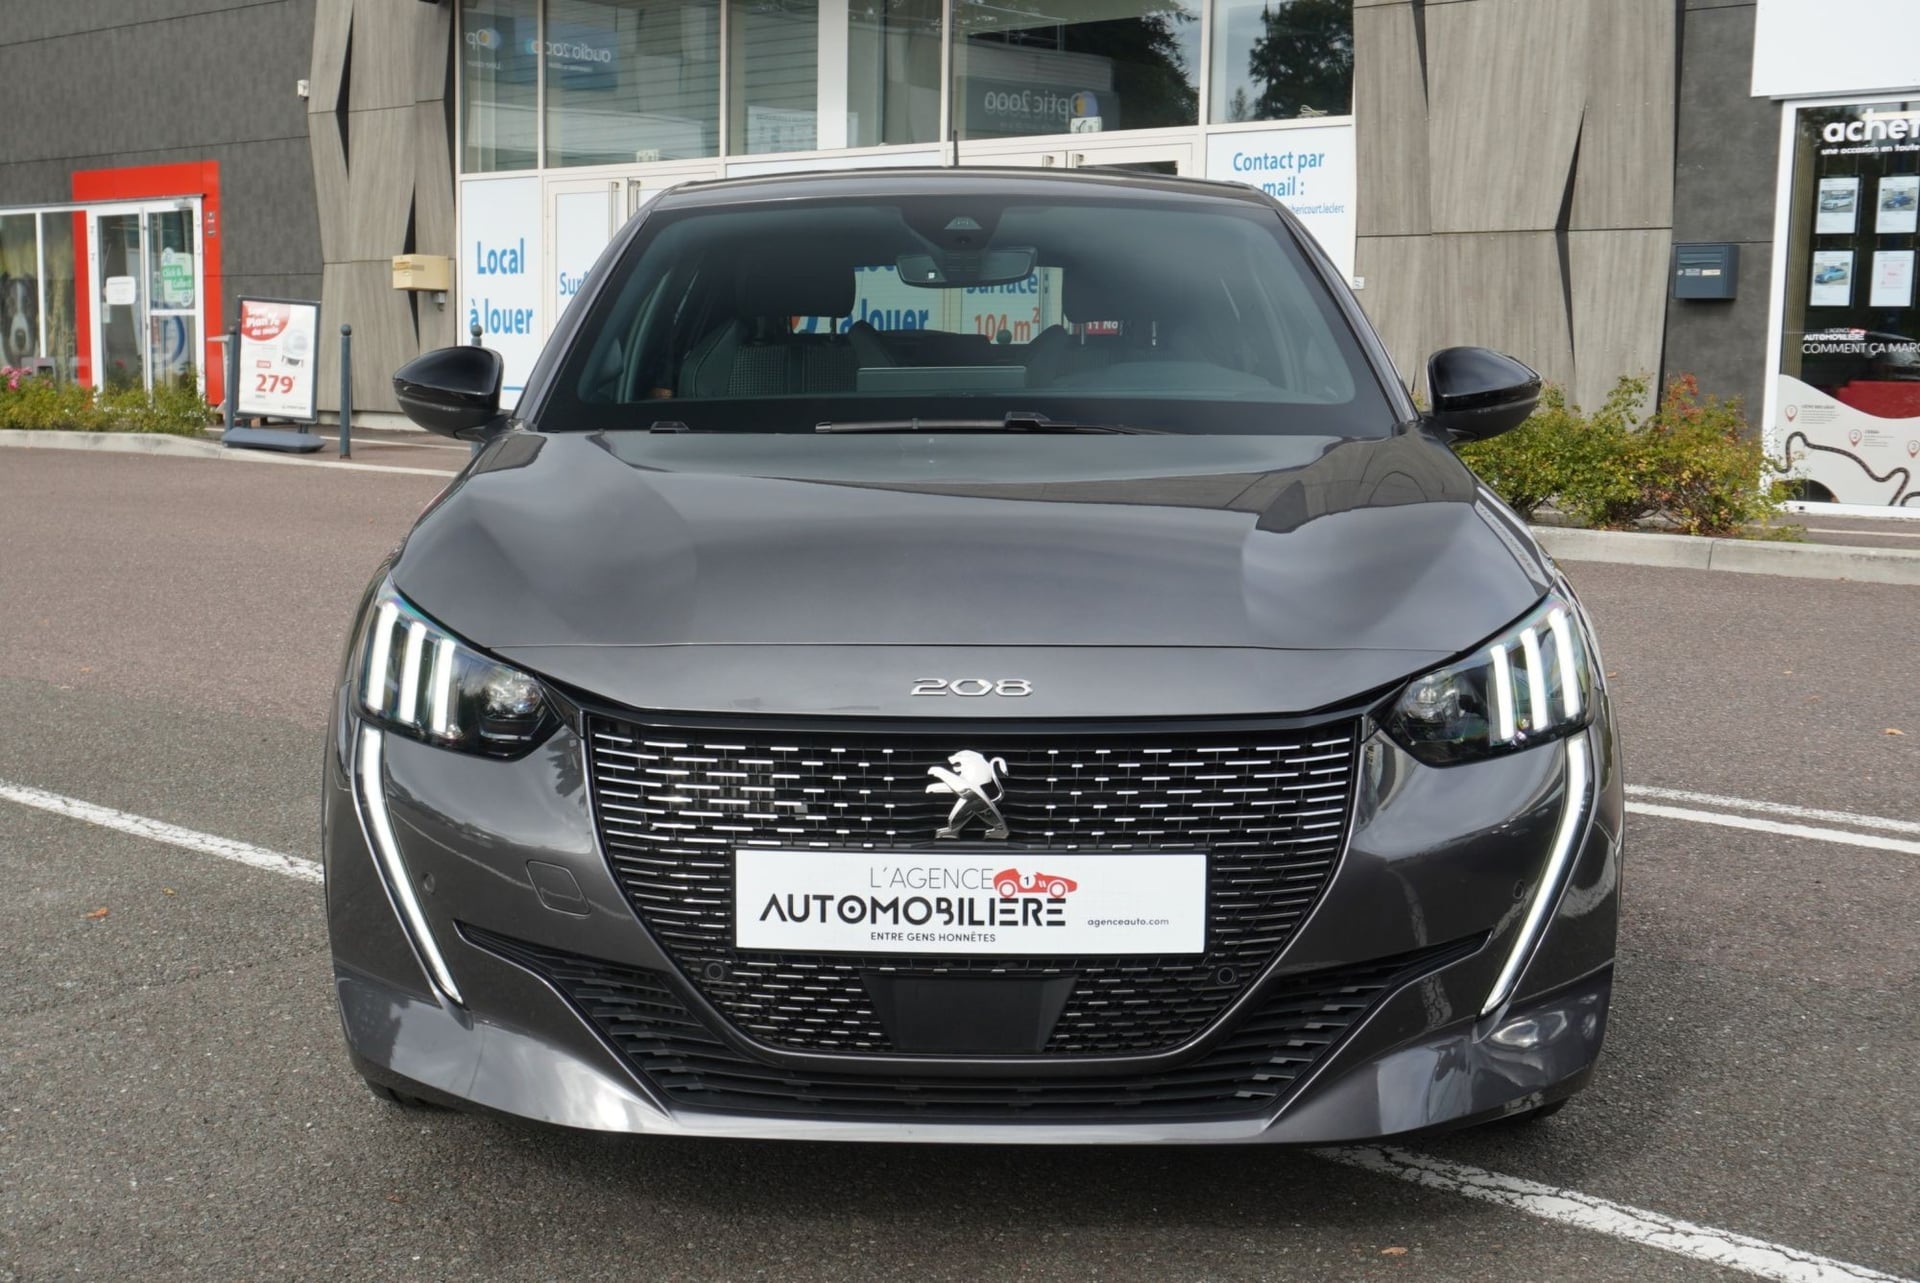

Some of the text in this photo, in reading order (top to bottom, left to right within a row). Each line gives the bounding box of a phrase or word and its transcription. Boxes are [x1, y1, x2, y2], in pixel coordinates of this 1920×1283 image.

[1232, 151, 1325, 173] Contact par
[476, 237, 525, 275] Local
[484, 297, 534, 335] louer
[1802, 343, 1867, 353] COMMENT
[911, 677, 1034, 697] 208
[1087, 917, 1170, 928] agenceauto.com
[870, 931, 996, 943] ENTRE GENS HONNÊTES
